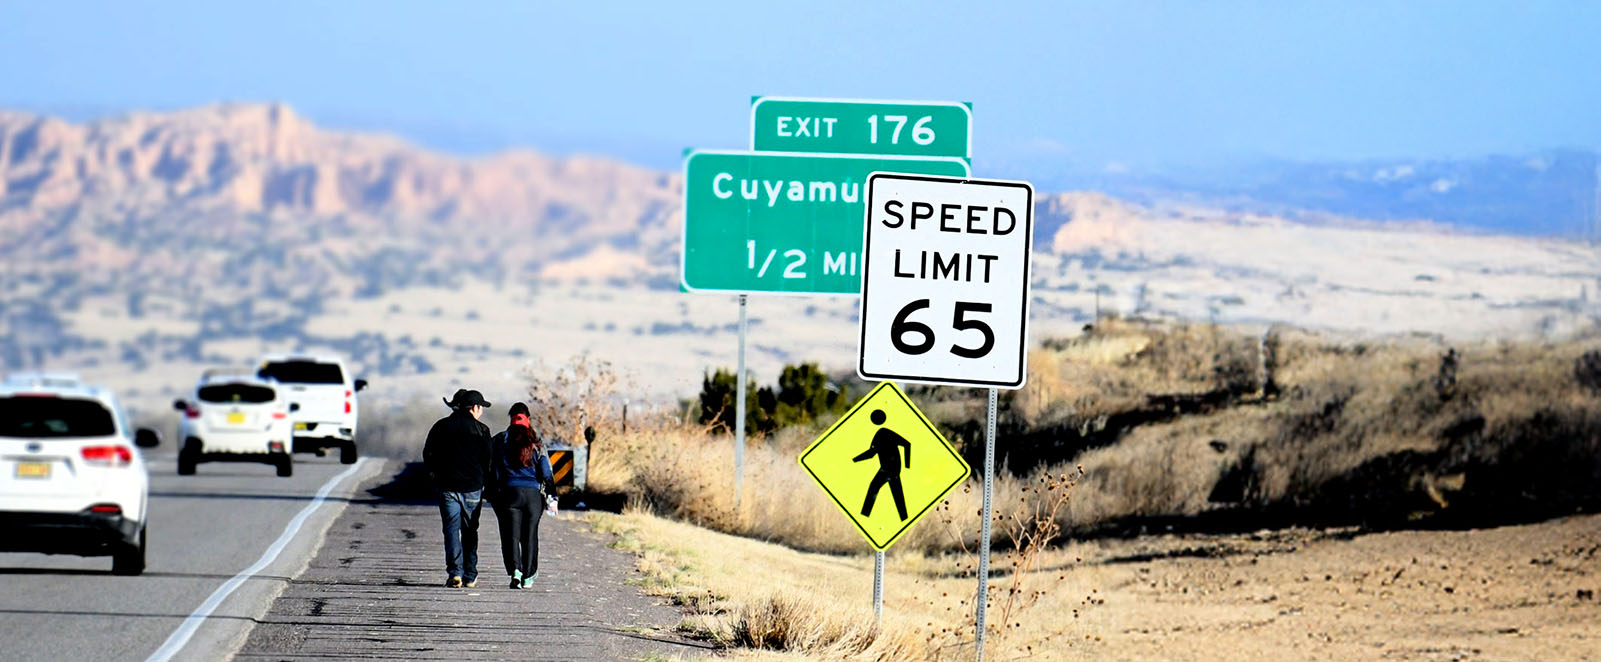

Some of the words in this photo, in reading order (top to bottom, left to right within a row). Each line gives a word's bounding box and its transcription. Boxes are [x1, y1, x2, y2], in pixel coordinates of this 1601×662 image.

[776, 116, 838, 138] EXIT
[867, 115, 936, 145] 176
[713, 172, 867, 207] Cuyamu
[881, 199, 1016, 236] SPEED
[746, 240, 807, 279] 1/2
[823, 251, 862, 276] MI
[893, 249, 998, 283] LIMIT
[890, 299, 995, 359] 65
